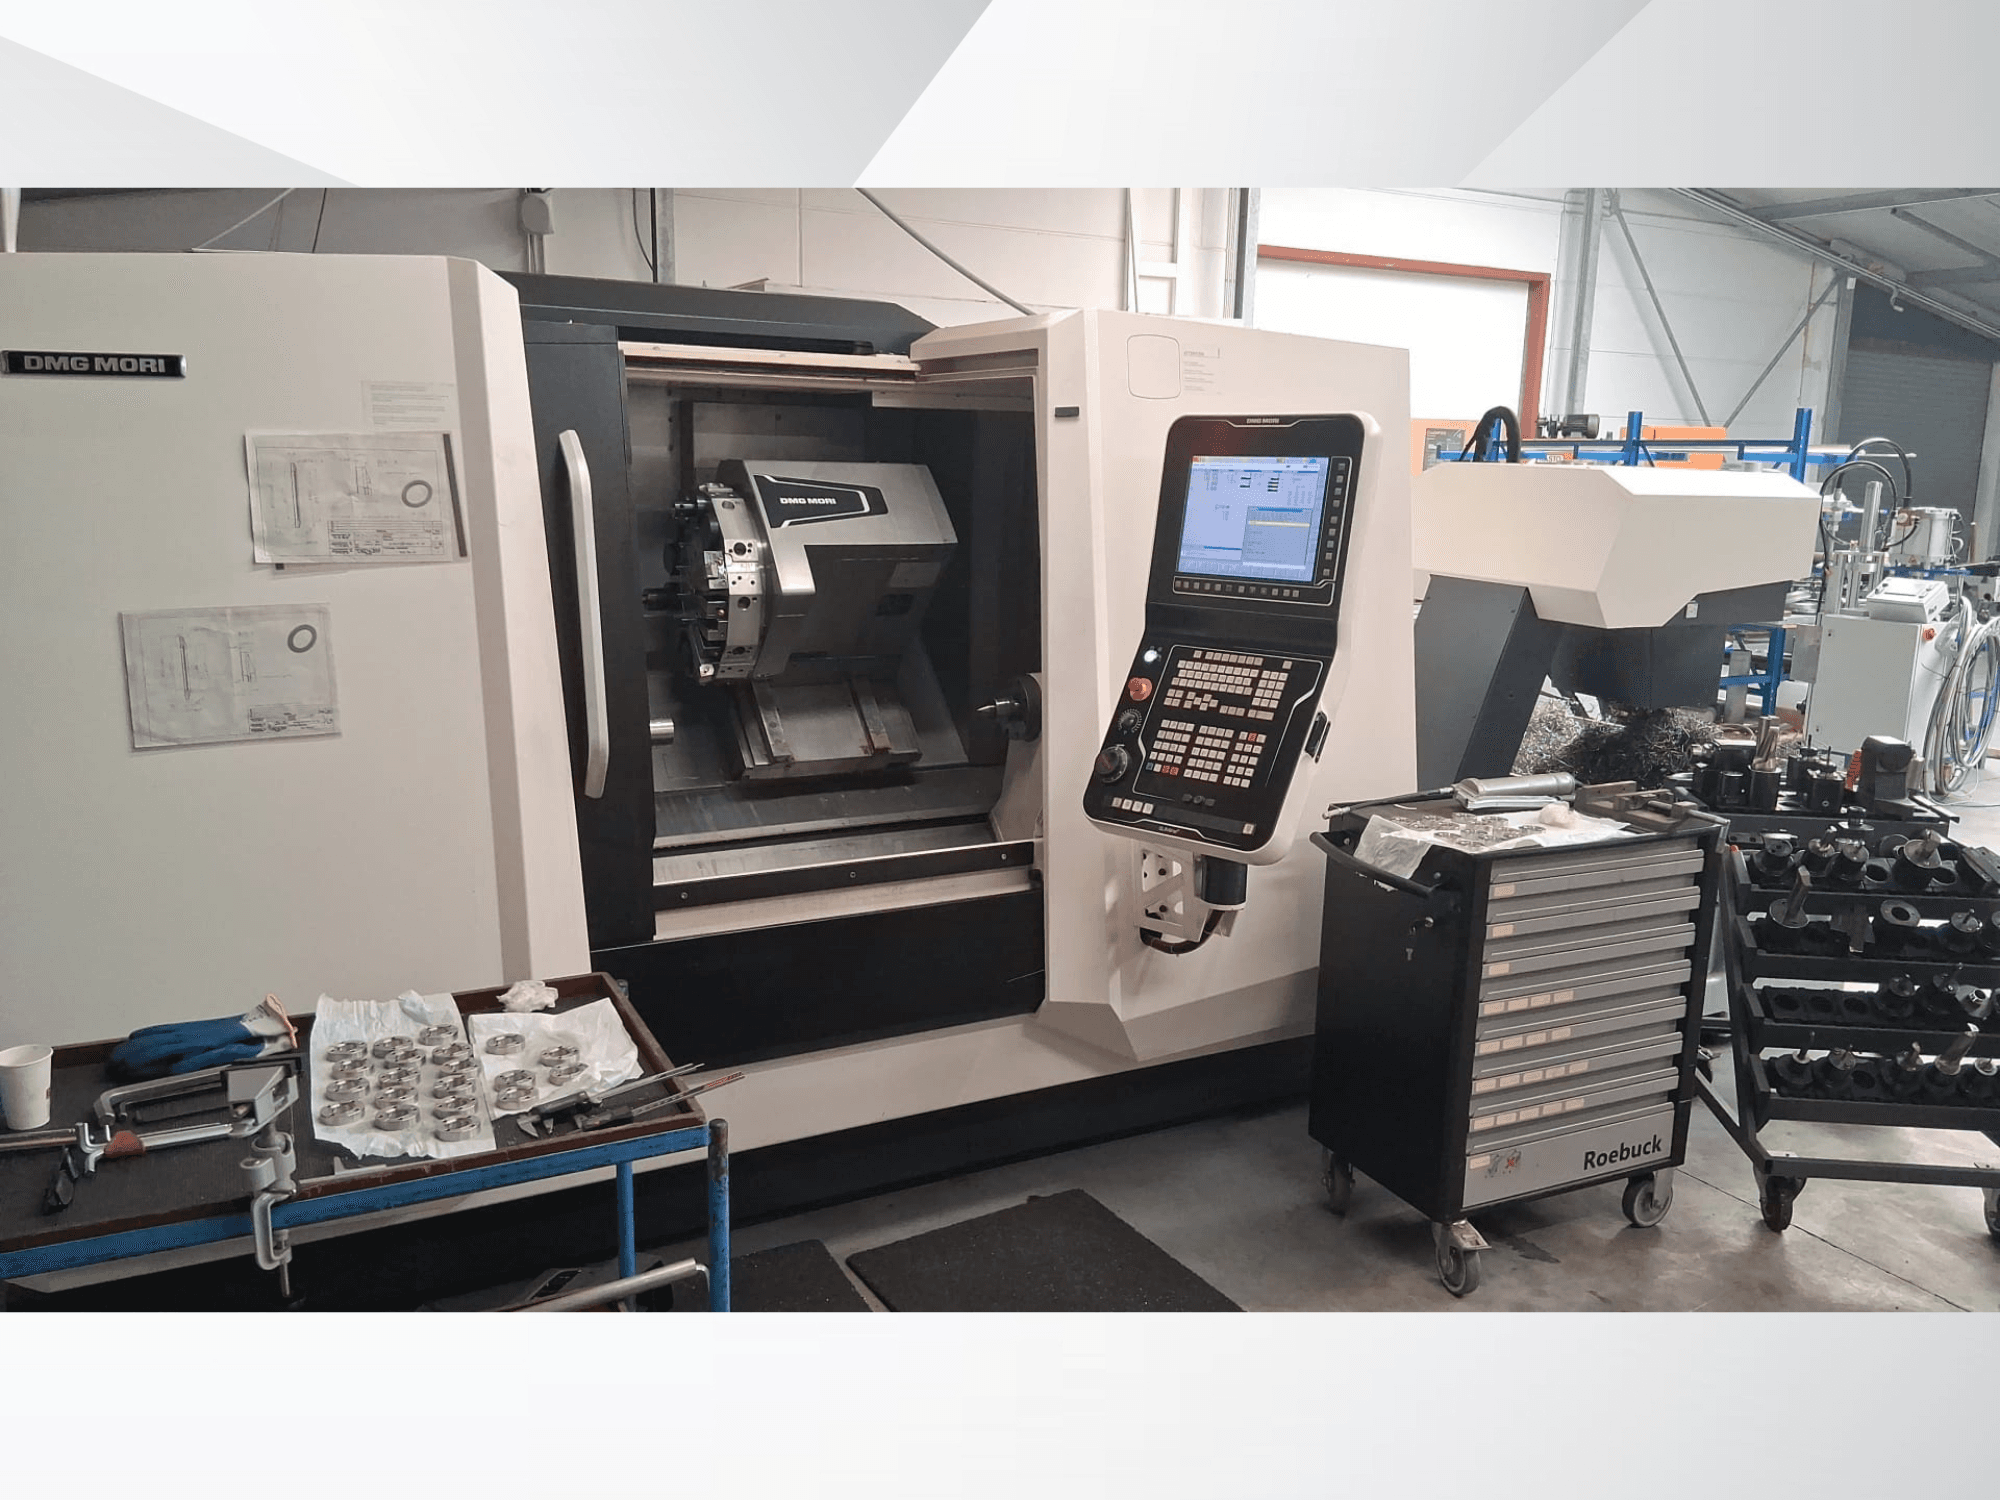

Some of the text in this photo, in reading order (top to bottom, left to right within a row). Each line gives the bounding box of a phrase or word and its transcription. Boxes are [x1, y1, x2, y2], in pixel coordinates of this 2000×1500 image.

[24, 355, 166, 373] DMG MORI
[779, 497, 837, 505] DMG MORI
[1583, 1134, 1662, 1170] Roebuck
